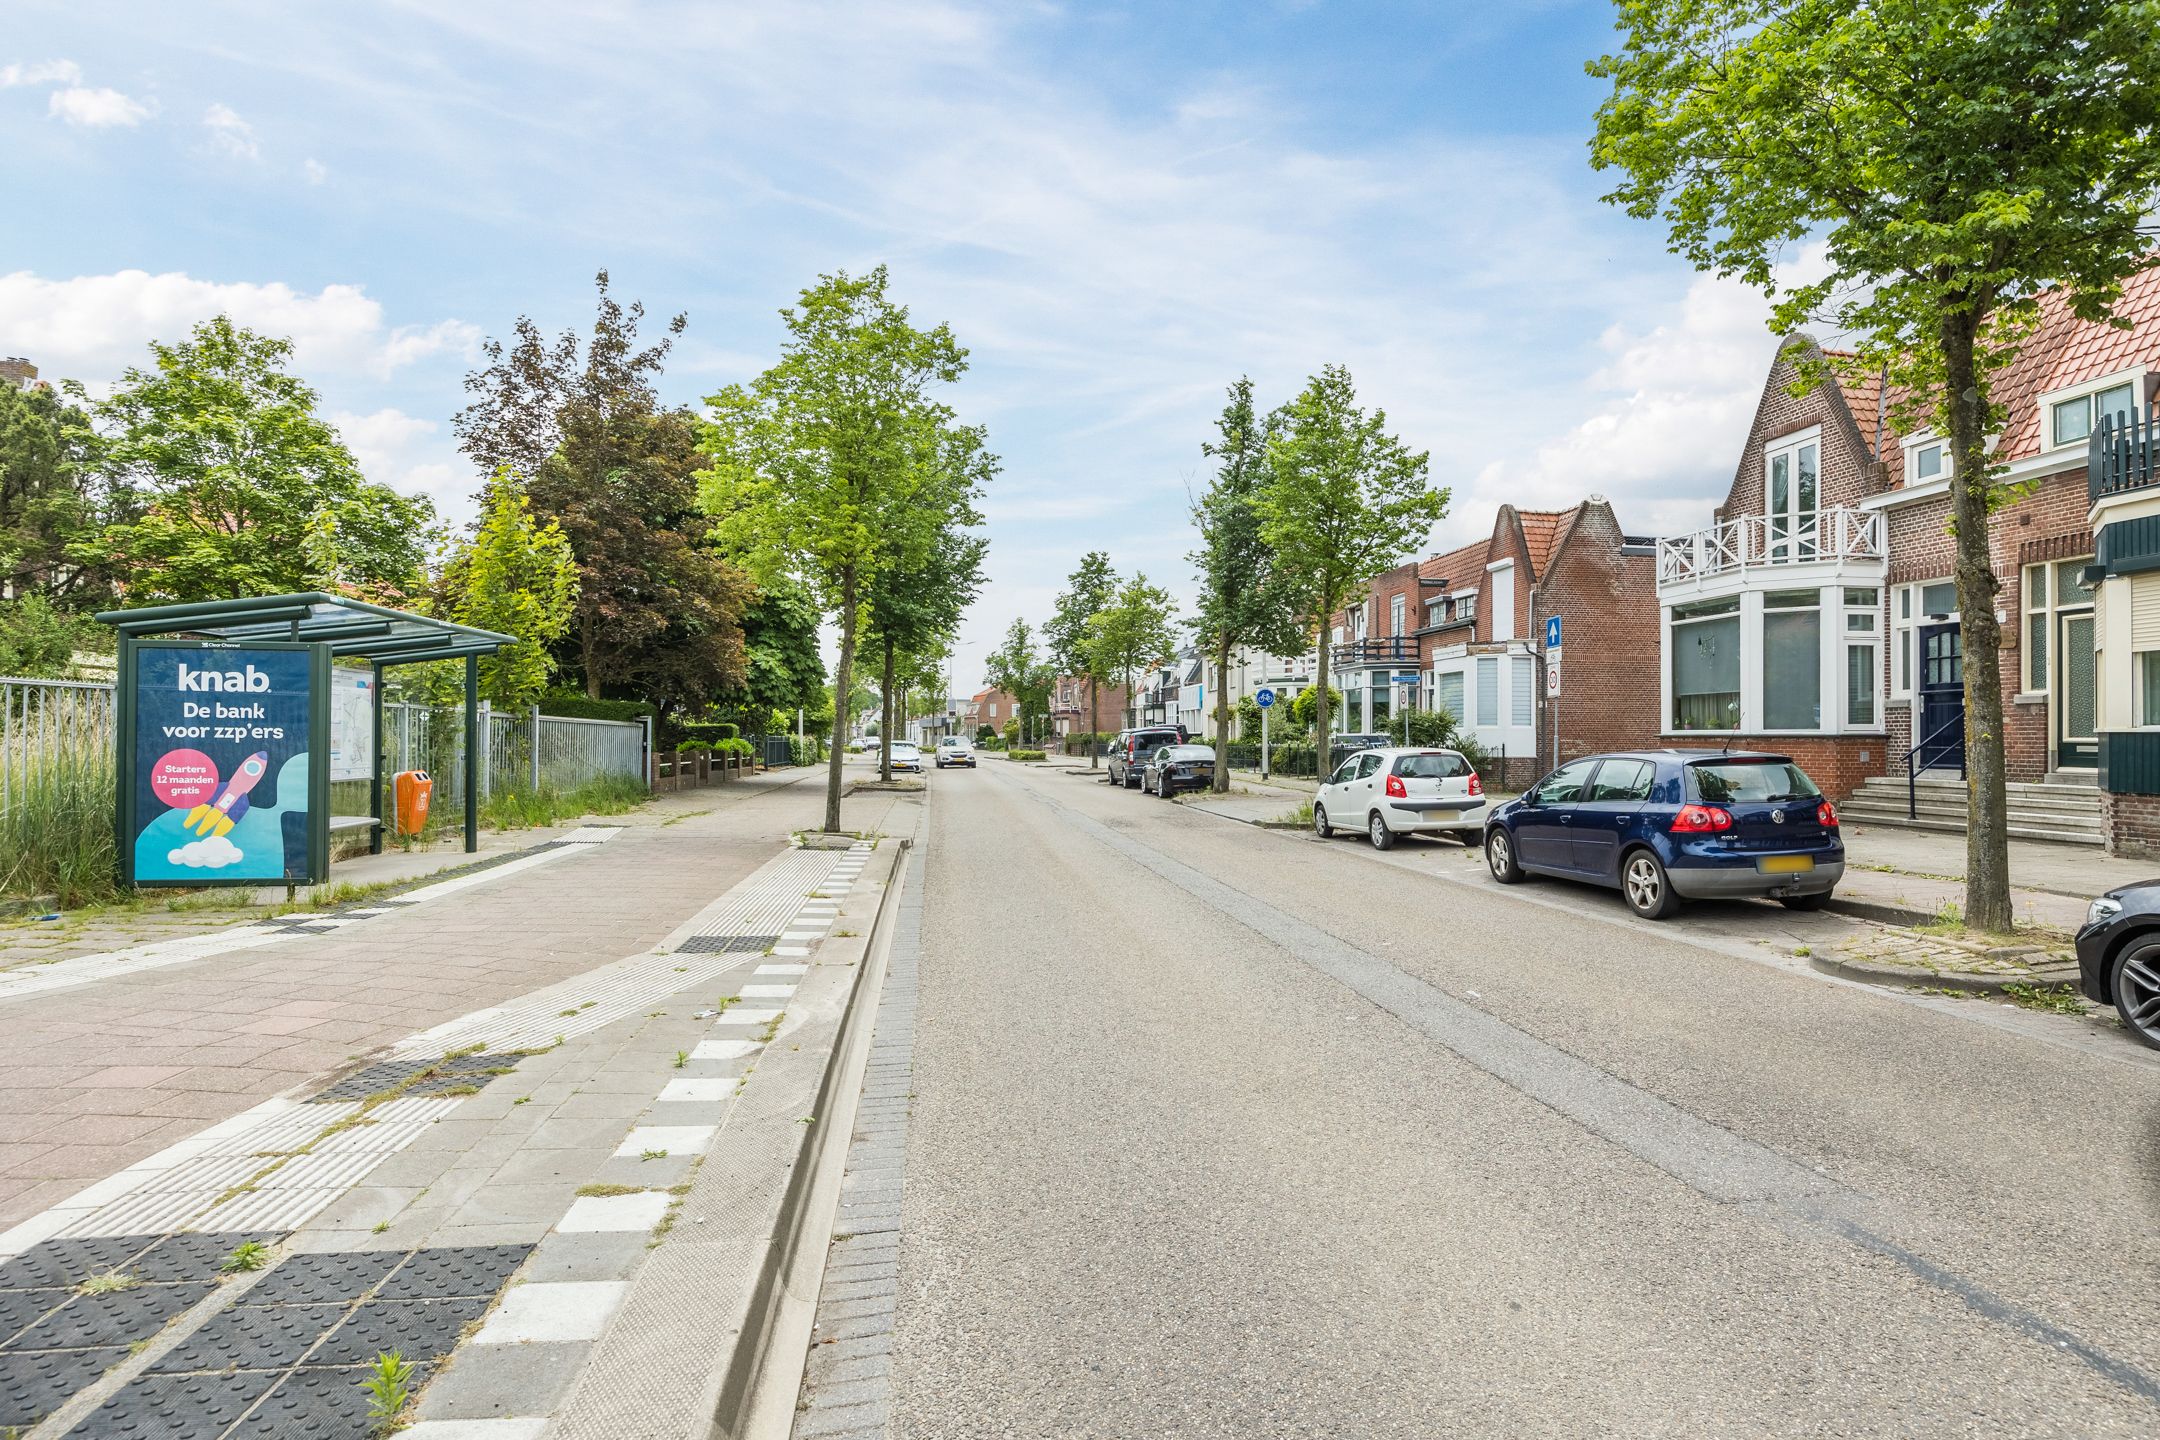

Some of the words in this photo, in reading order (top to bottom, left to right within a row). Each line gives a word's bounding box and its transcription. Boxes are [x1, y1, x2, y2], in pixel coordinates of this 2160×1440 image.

[183, 702, 211, 719] De
[215, 702, 265, 719] bank
[162, 726, 210, 739] voor
[213, 722, 284, 744] zzp'ers
[165, 764, 207, 773] Starters
[156, 775, 168, 784] 12
[169, 775, 214, 784] maanden
[171, 786, 200, 797] gratis
